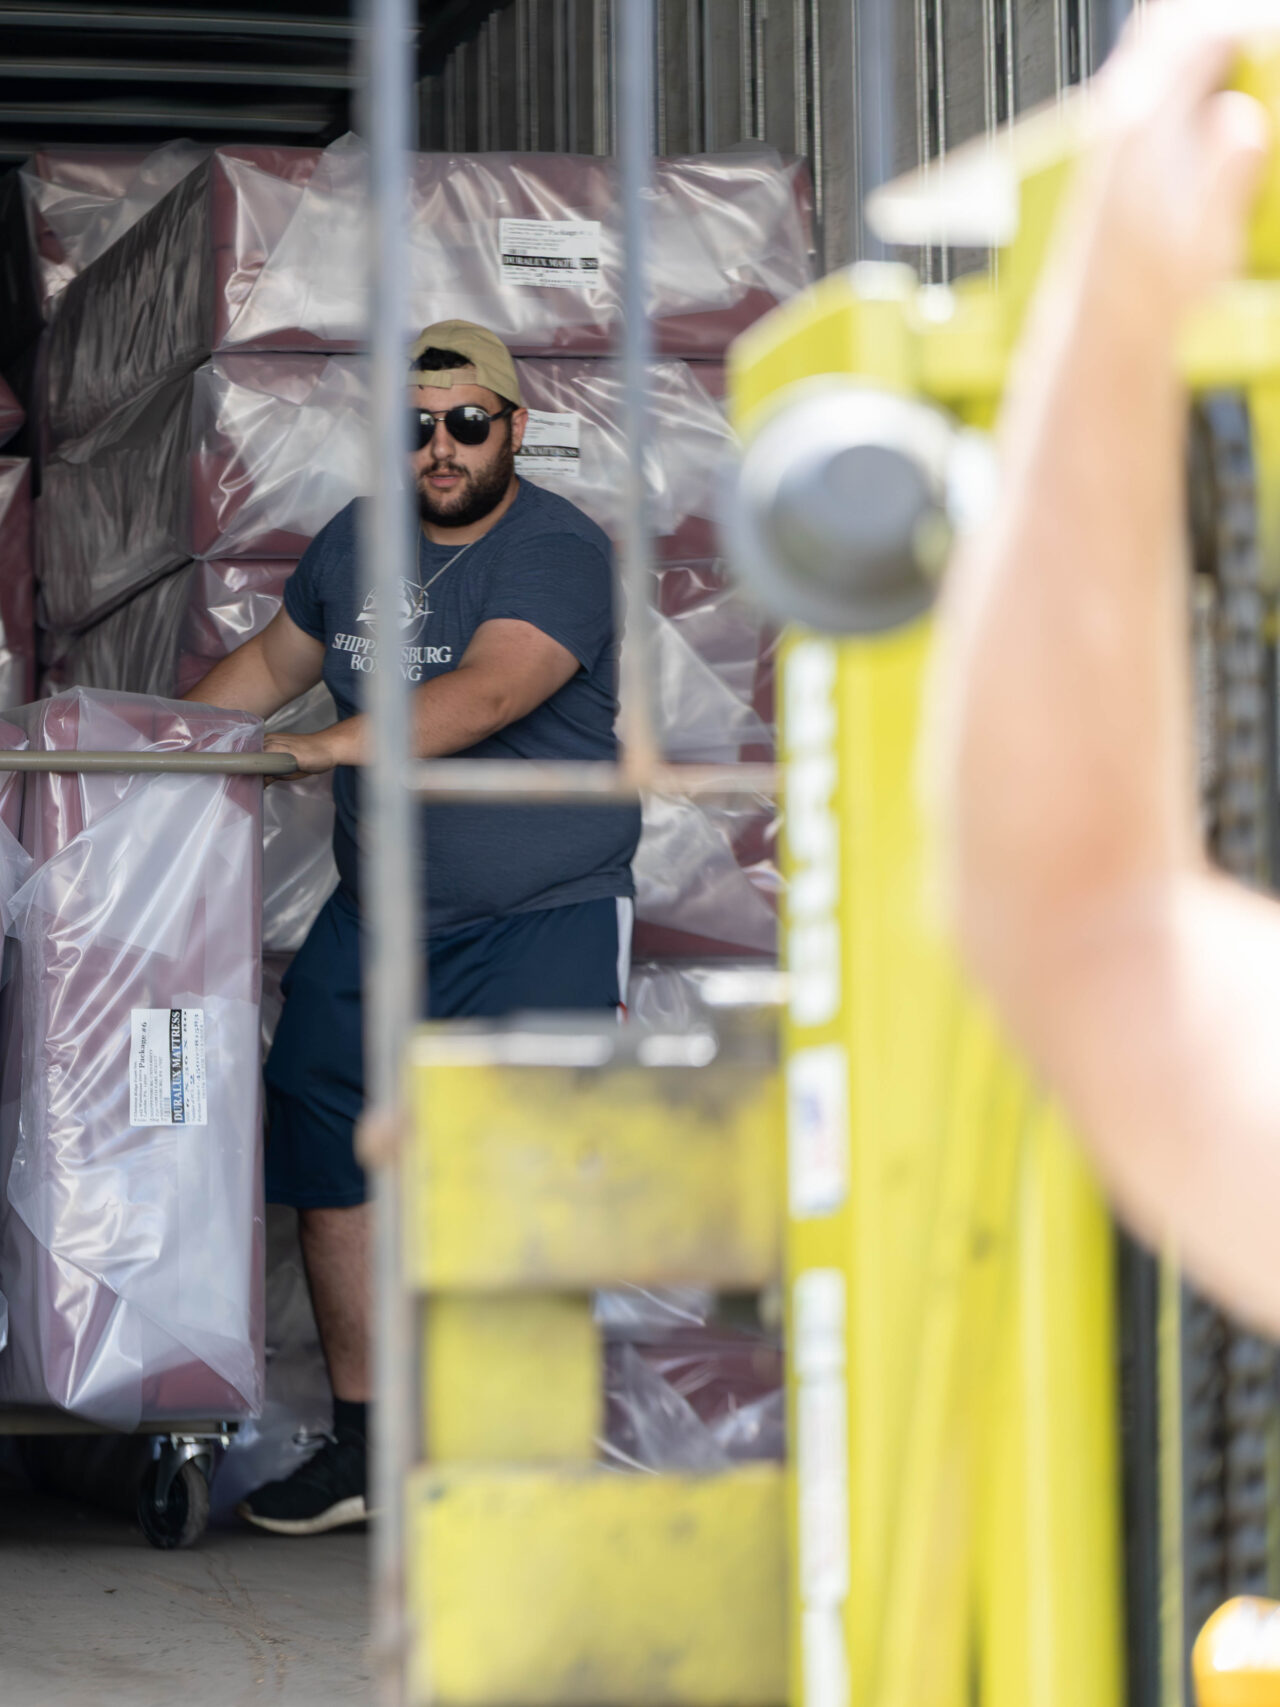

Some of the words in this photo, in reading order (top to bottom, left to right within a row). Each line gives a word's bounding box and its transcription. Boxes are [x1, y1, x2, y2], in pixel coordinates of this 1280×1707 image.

[332, 632, 452, 664] SHIPPSBURG
[351, 654, 423, 681] BONG
[139, 1035, 147, 1068] Package
[171, 1011, 181, 1067] MATTRESS
[173, 1070, 183, 1120] DURALUX
